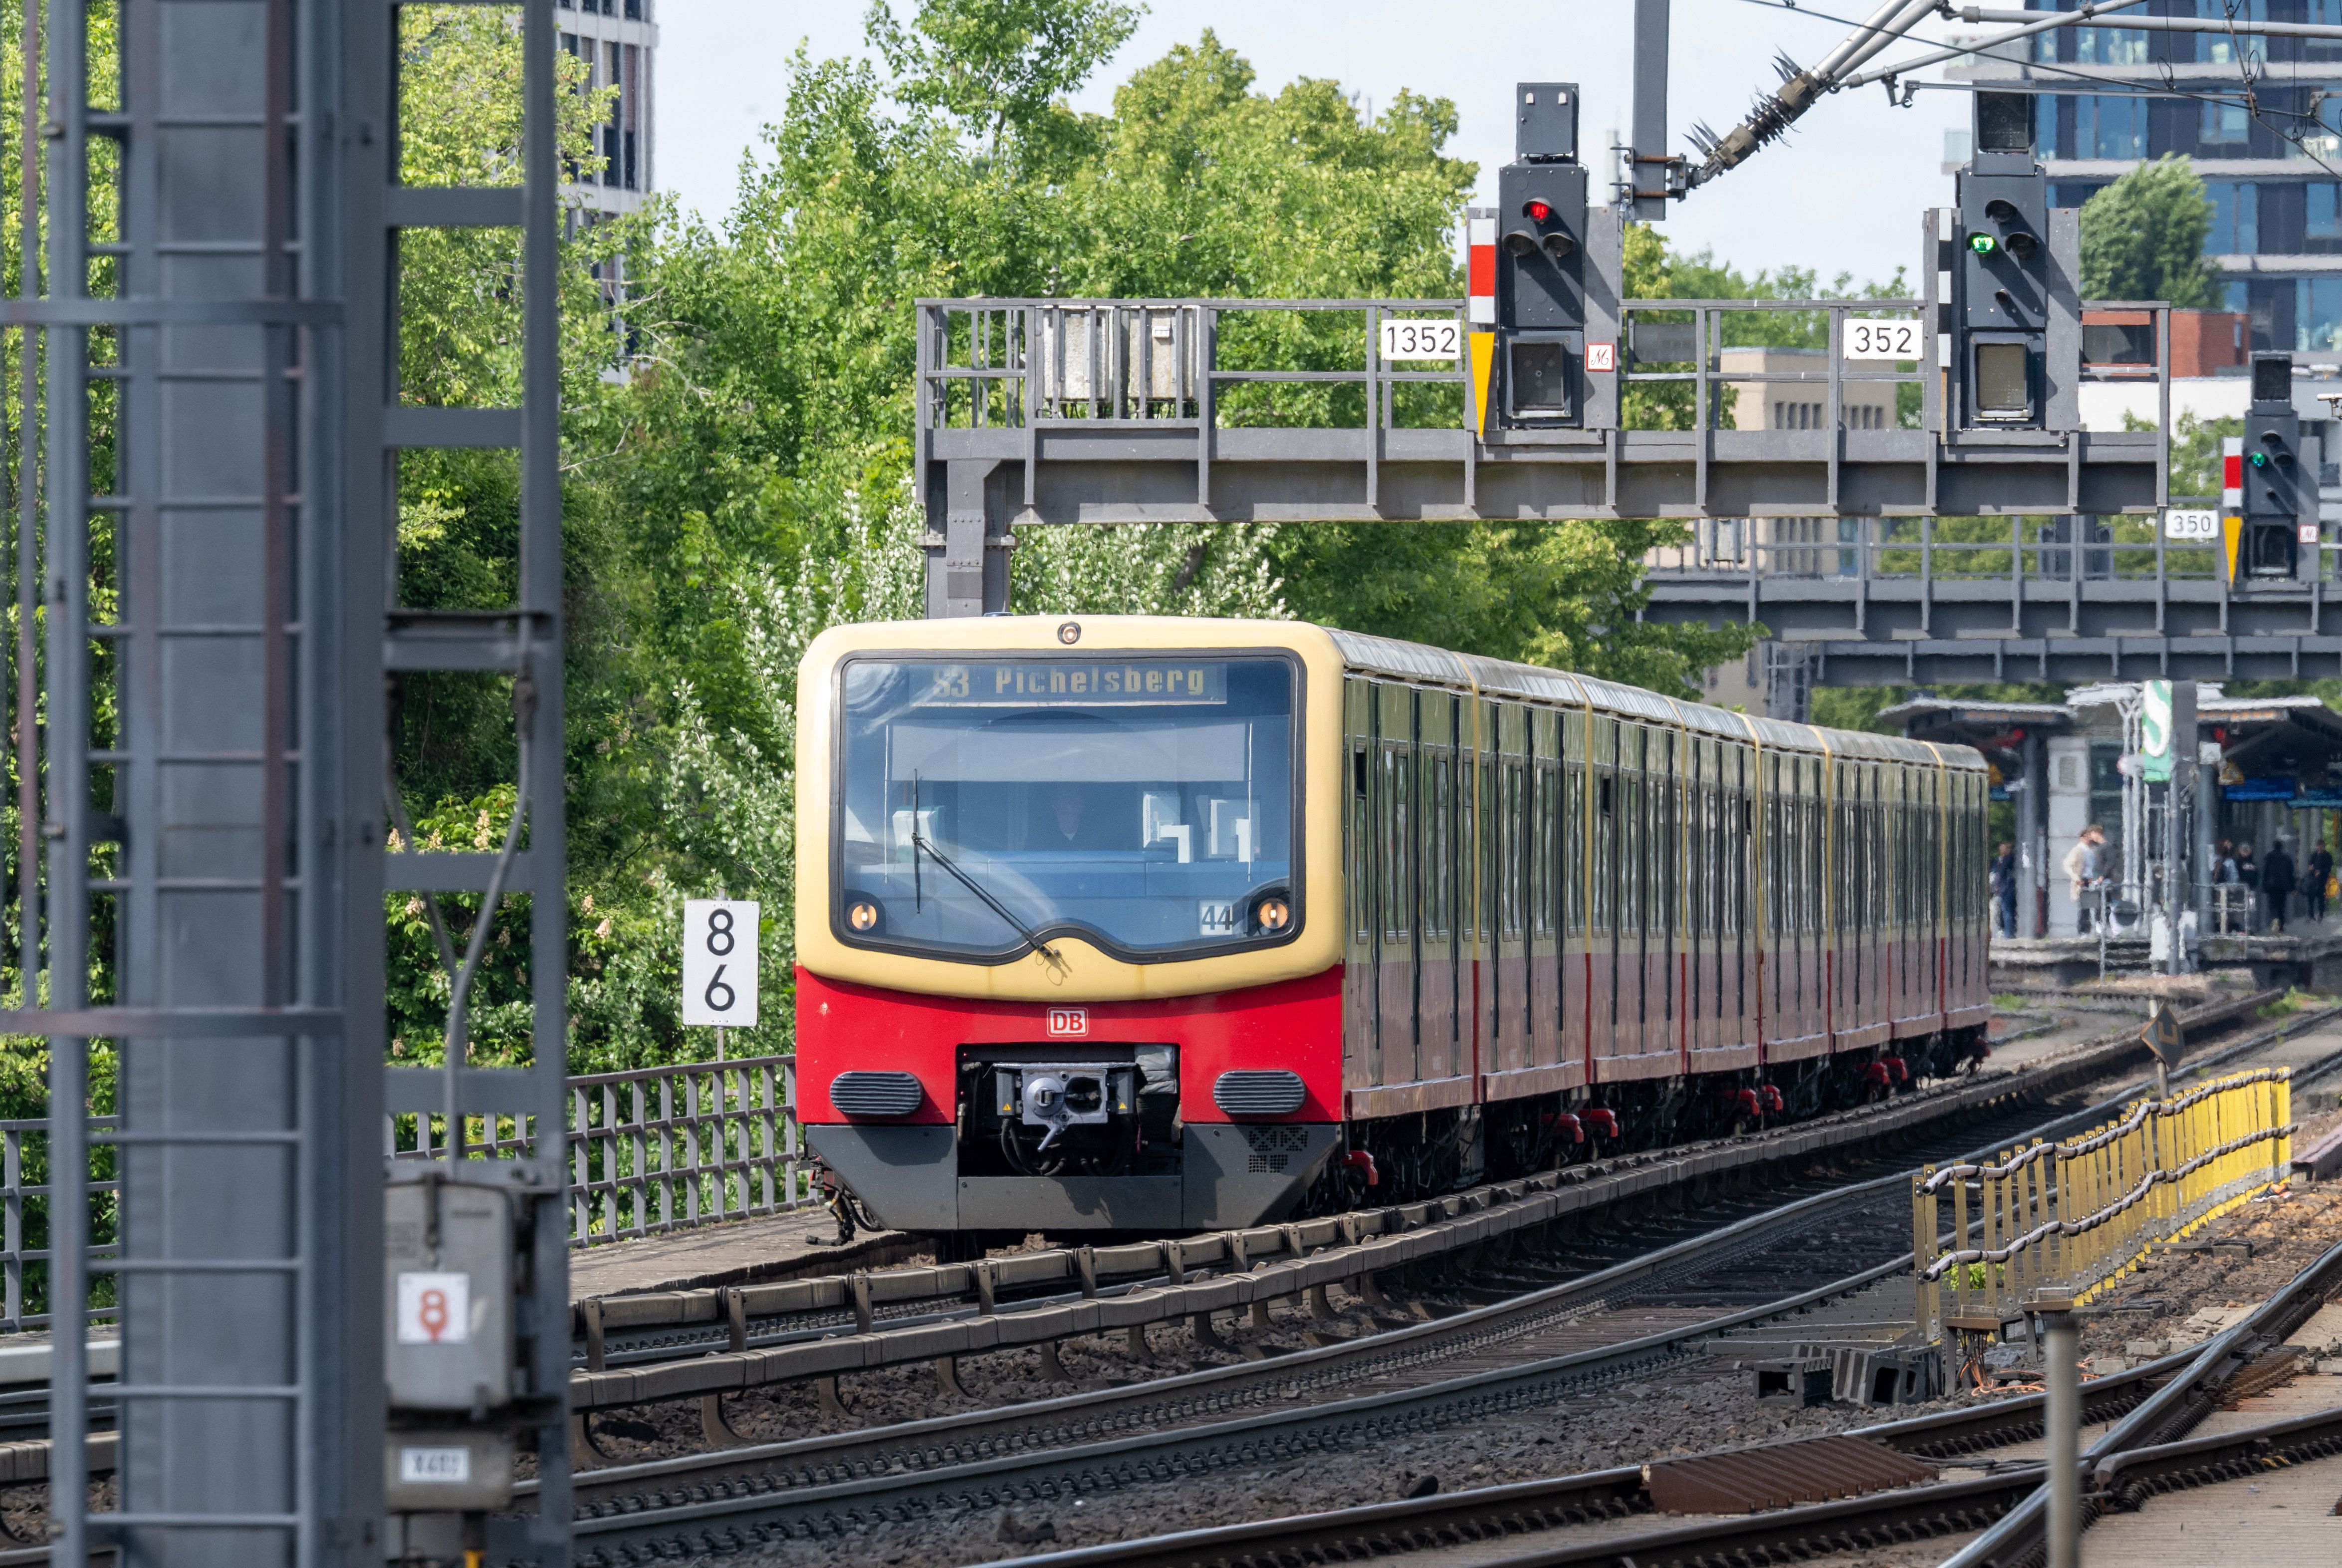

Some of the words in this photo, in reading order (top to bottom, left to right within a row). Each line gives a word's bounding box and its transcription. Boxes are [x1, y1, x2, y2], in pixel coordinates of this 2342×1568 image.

[1387, 326, 1456, 354] 1352
[1856, 326, 1911, 354] 352
[2174, 515, 2211, 532] 350
[933, 667, 969, 697] S3
[996, 666, 1203, 695] Pichelsberg
[1201, 905, 1233, 930] 44
[707, 908, 734, 956] 8
[705, 964, 735, 1012] 6
[1053, 1012, 1083, 1031] DB
